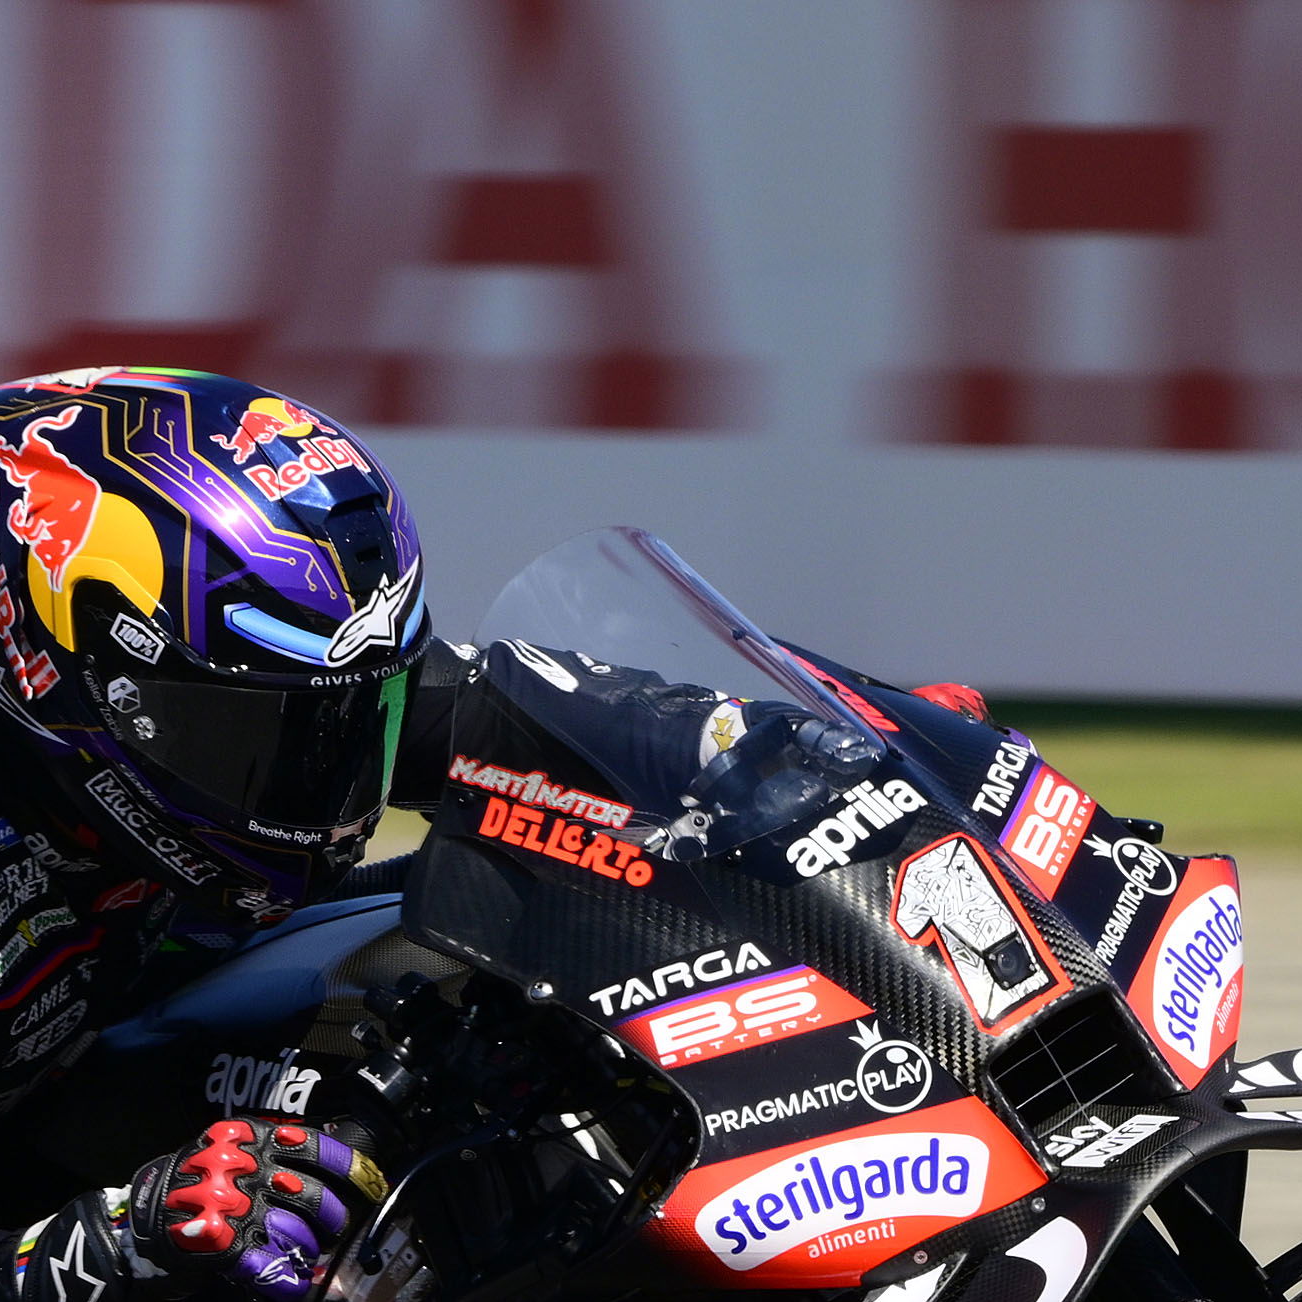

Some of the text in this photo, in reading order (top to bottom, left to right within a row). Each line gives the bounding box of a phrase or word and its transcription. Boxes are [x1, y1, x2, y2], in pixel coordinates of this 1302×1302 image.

[971, 741, 1030, 817] TARGA
[249, 820, 322, 844] Breathe Right
[786, 779, 928, 878] aprilia
[1011, 774, 1079, 870] BS
[1048, 793, 1092, 877] BATTERY
[889, 832, 1075, 1037] 1
[1094, 845, 1161, 967] PRAGMATIC PLAY
[589, 942, 772, 1017] TARGA
[1162, 896, 1242, 1051] sterilgarda
[649, 977, 818, 1056] BS
[659, 1016, 822, 1067] BATTERY
[204, 1046, 323, 1119] aprilia
[704, 1059, 923, 1136] PRAGMATIC PLAY
[1045, 1115, 1114, 1158] sky
[715, 1137, 970, 1255] sterilgarda
[807, 1219, 897, 1260] alimenti
